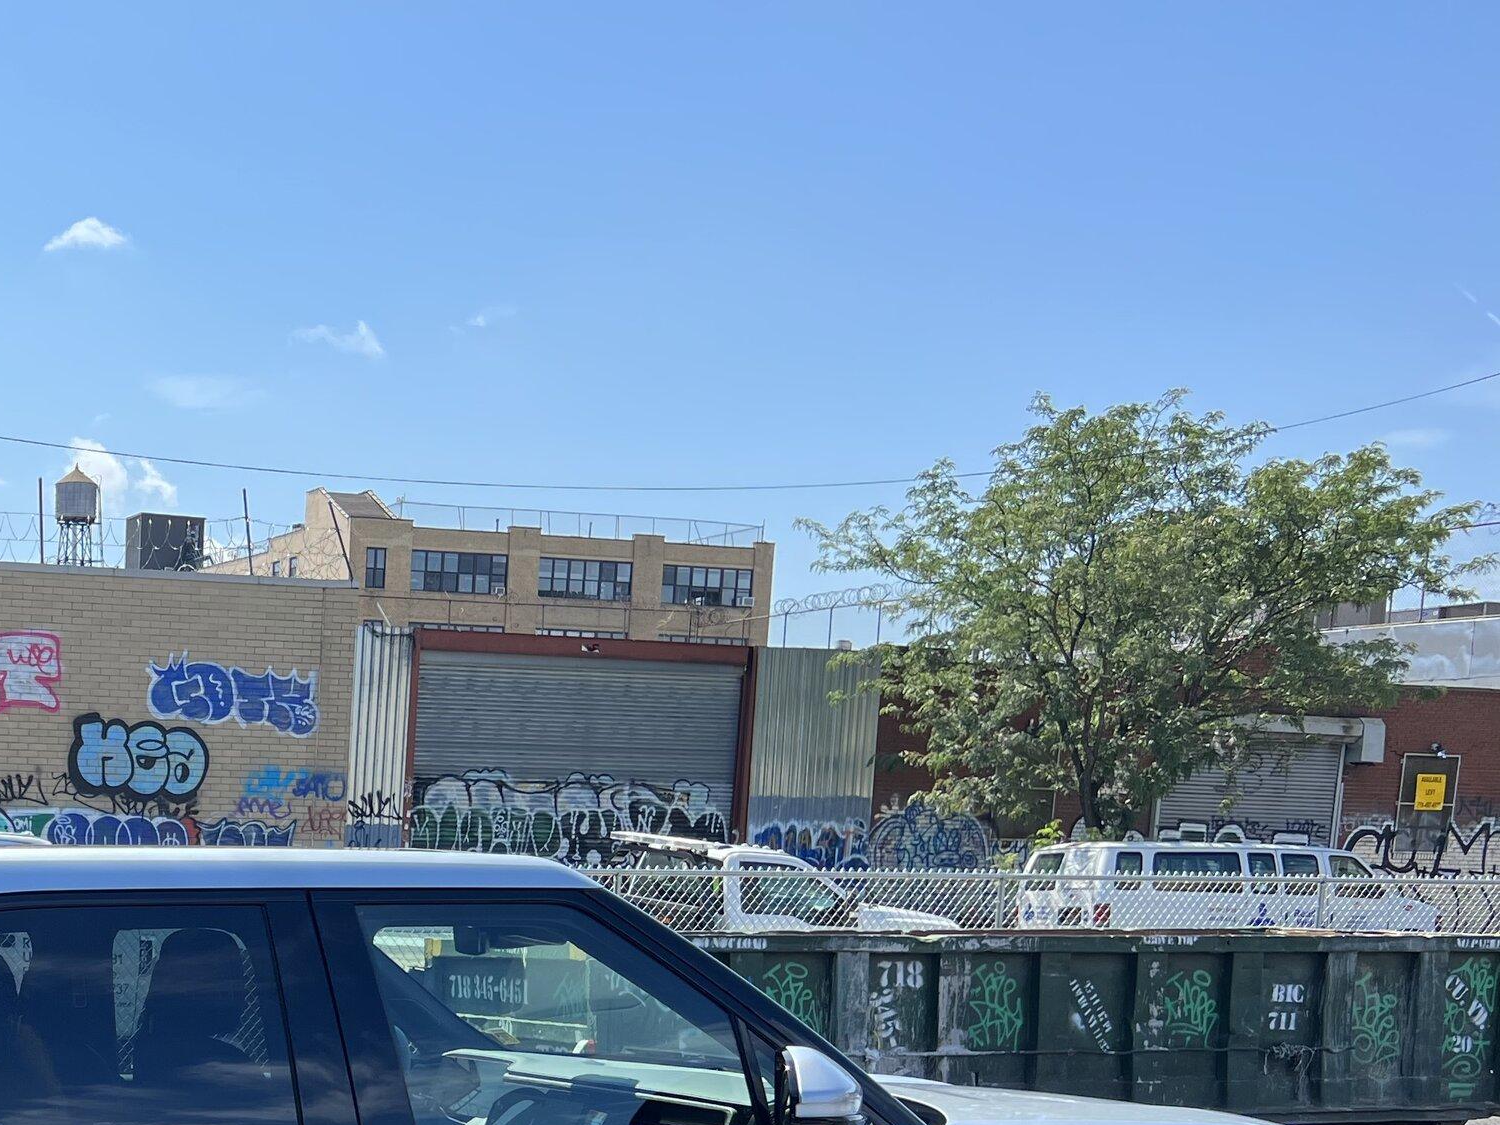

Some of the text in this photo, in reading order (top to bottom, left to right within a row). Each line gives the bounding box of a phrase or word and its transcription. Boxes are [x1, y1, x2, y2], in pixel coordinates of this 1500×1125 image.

[877, 961, 924, 989] 718
[449, 974, 471, 999] 718
[1268, 1011, 1297, 1030] 711
[1453, 1035, 1473, 1053] 20
